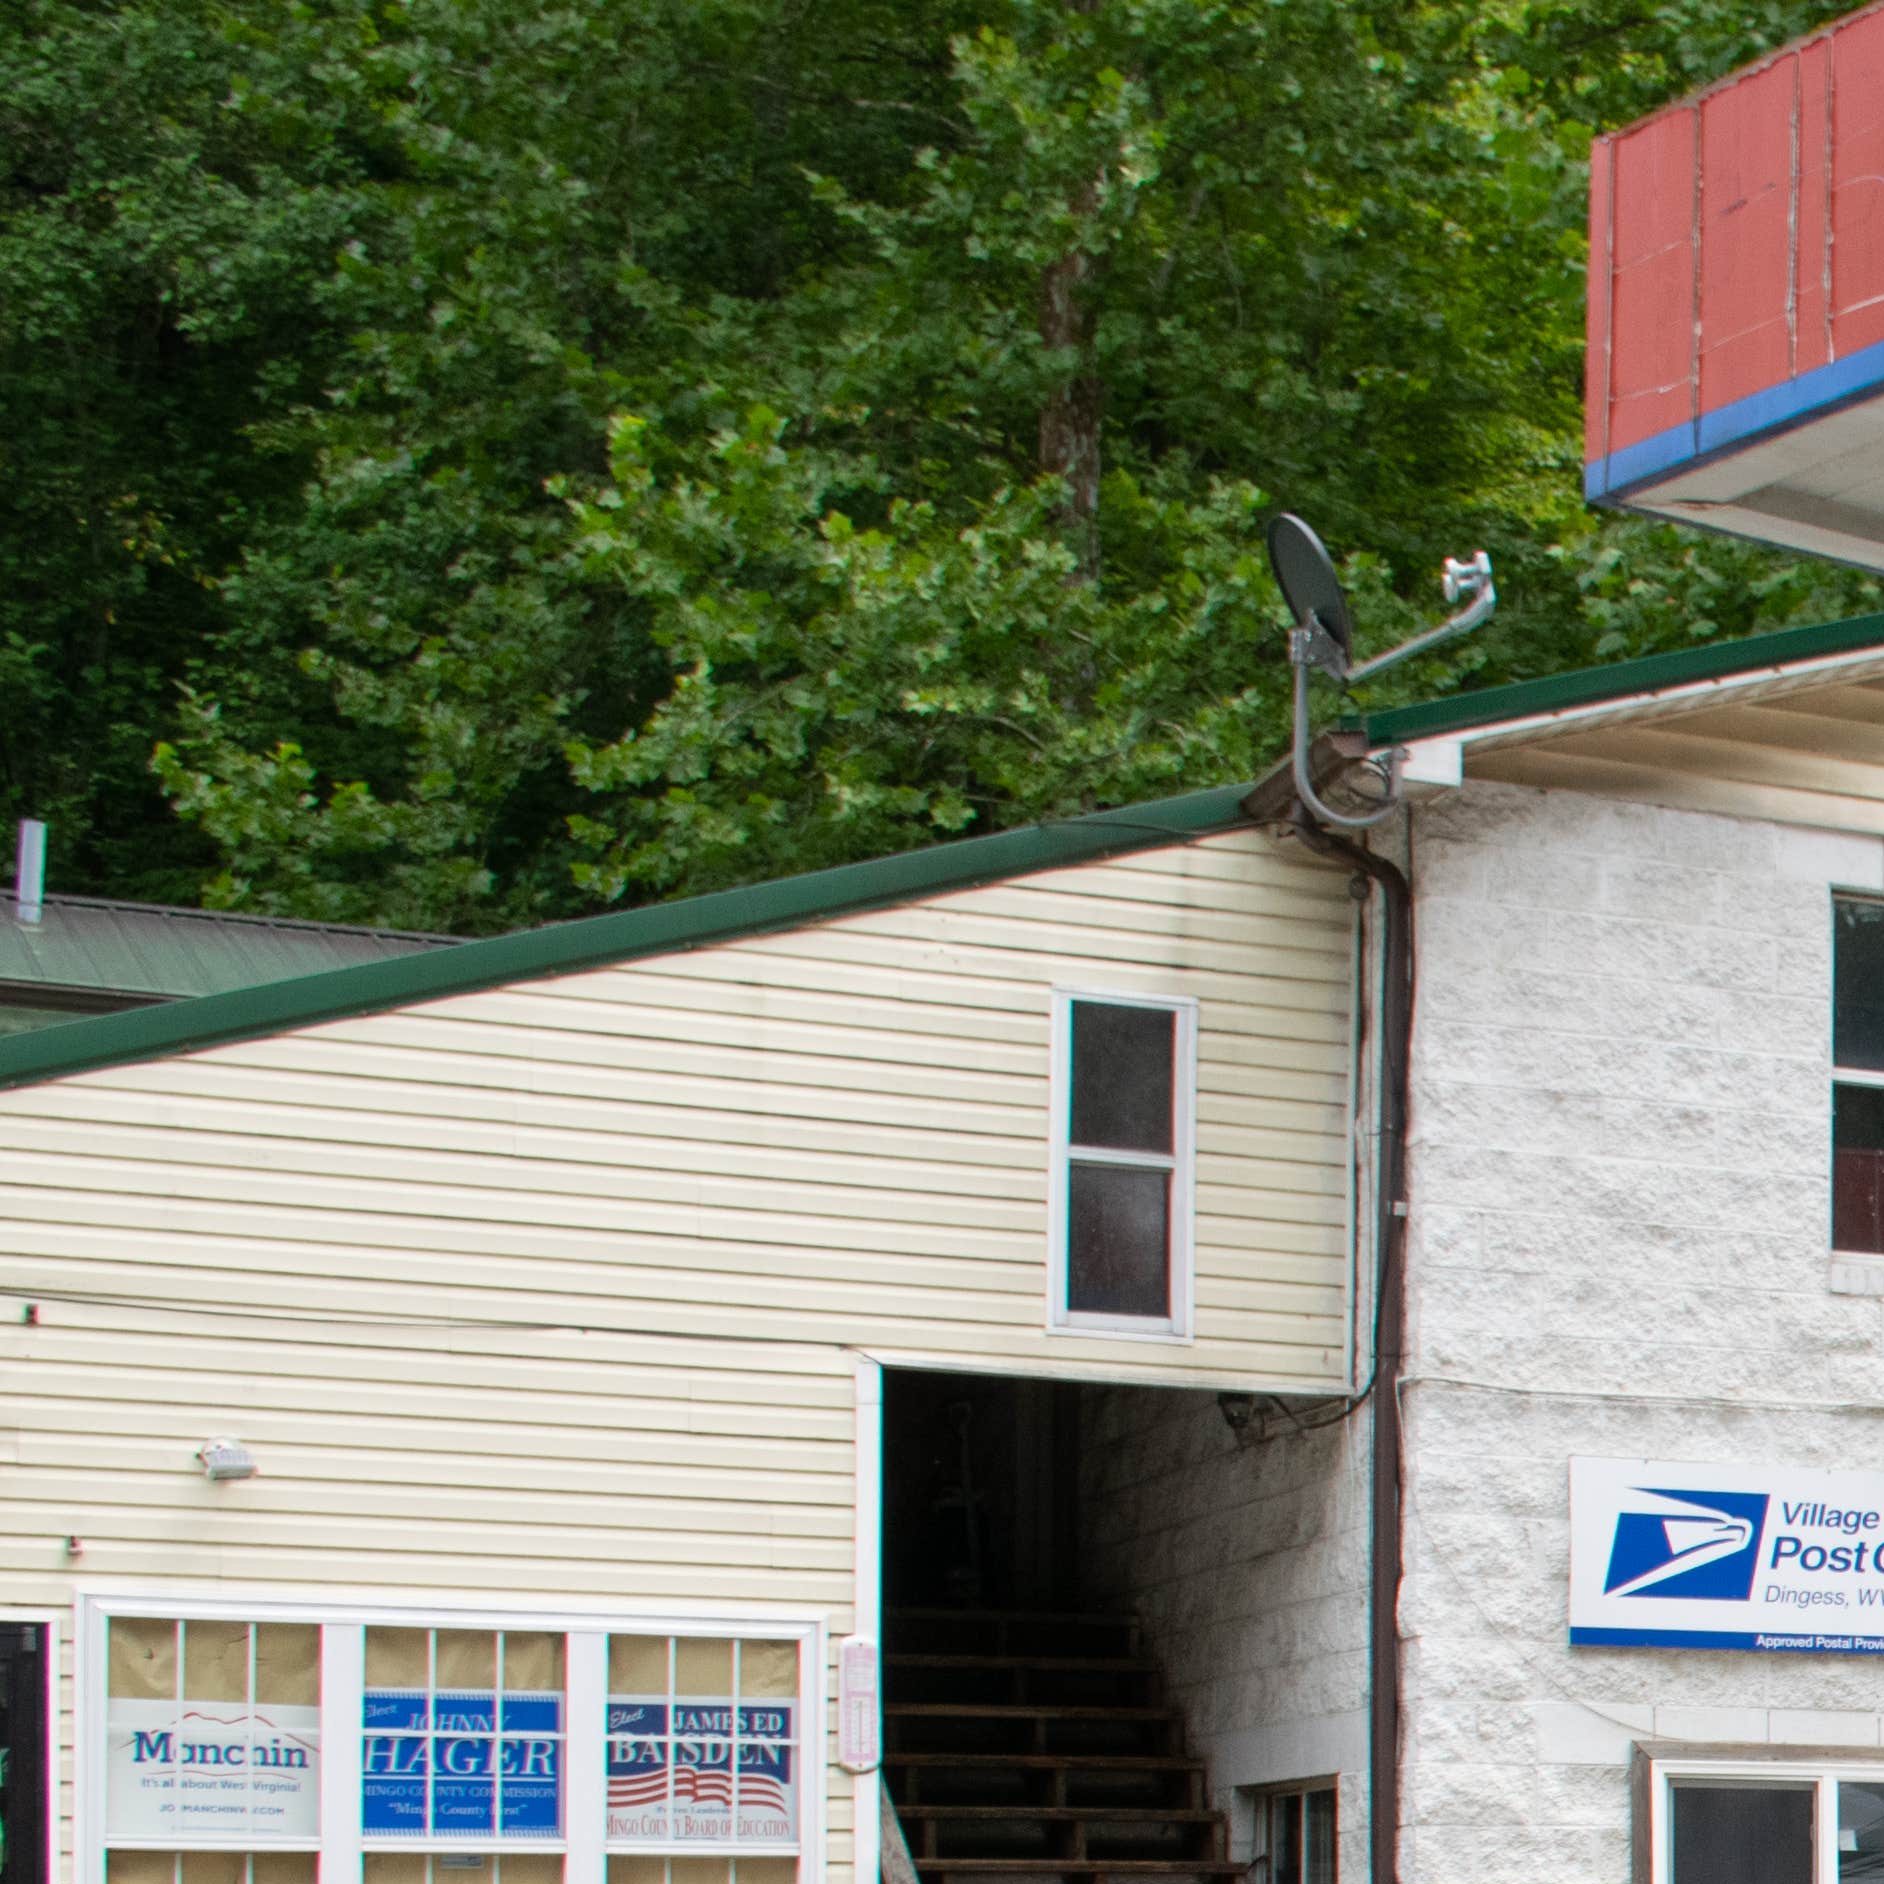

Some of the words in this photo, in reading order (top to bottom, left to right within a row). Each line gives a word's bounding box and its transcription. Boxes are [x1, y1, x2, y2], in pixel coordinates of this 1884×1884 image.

[1782, 1501, 1880, 1535] Village
[1770, 1536, 1869, 1573] Post
[1764, 1585, 1849, 1610] Dingess,
[1756, 1633, 1813, 1649] Approved
[1815, 1635, 1851, 1649] Postal
[610, 1708, 646, 1730] Elect
[674, 1711, 748, 1731] JAMES
[753, 1712, 784, 1732] ED
[363, 1736, 556, 1776] HAGER
[181, 1779, 217, 1790] about
[220, 1780, 246, 1791] Wes
[409, 1785, 466, 1798] CONTY
[468, 1786, 556, 1799] COMISSION
[640, 1814, 681, 1837] COUNY
[684, 1815, 719, 1837] BOARD
